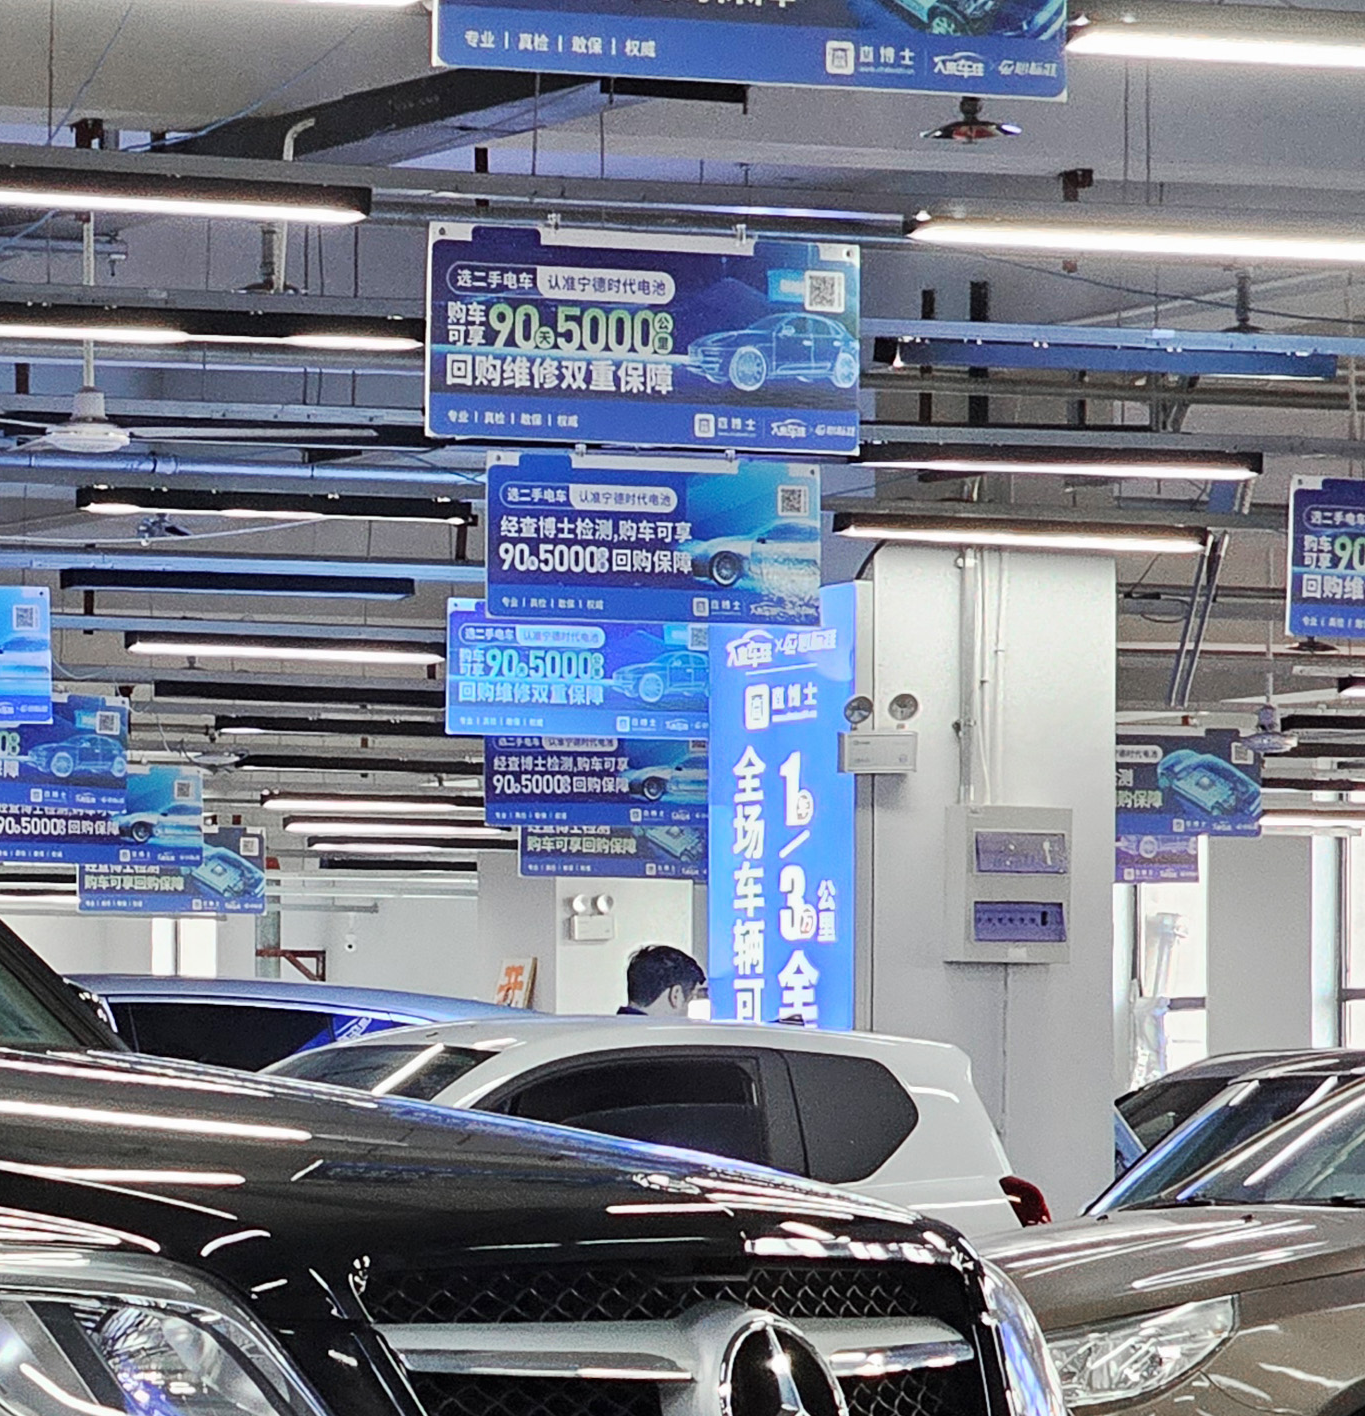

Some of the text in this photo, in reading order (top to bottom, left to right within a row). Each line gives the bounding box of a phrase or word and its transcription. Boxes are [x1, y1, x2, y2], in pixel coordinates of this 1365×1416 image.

[456, 269, 667, 297] 选二手电车 认准宁德时代电池
[447, 301, 487, 325] 购车
[447, 324, 487, 348] 可享
[446, 353, 674, 396] 回购维修双重保障
[611, 548, 694, 576] 回购保障
[1302, 574, 1365, 601] 回购维
[458, 681, 605, 706] 回购维修双重保障
